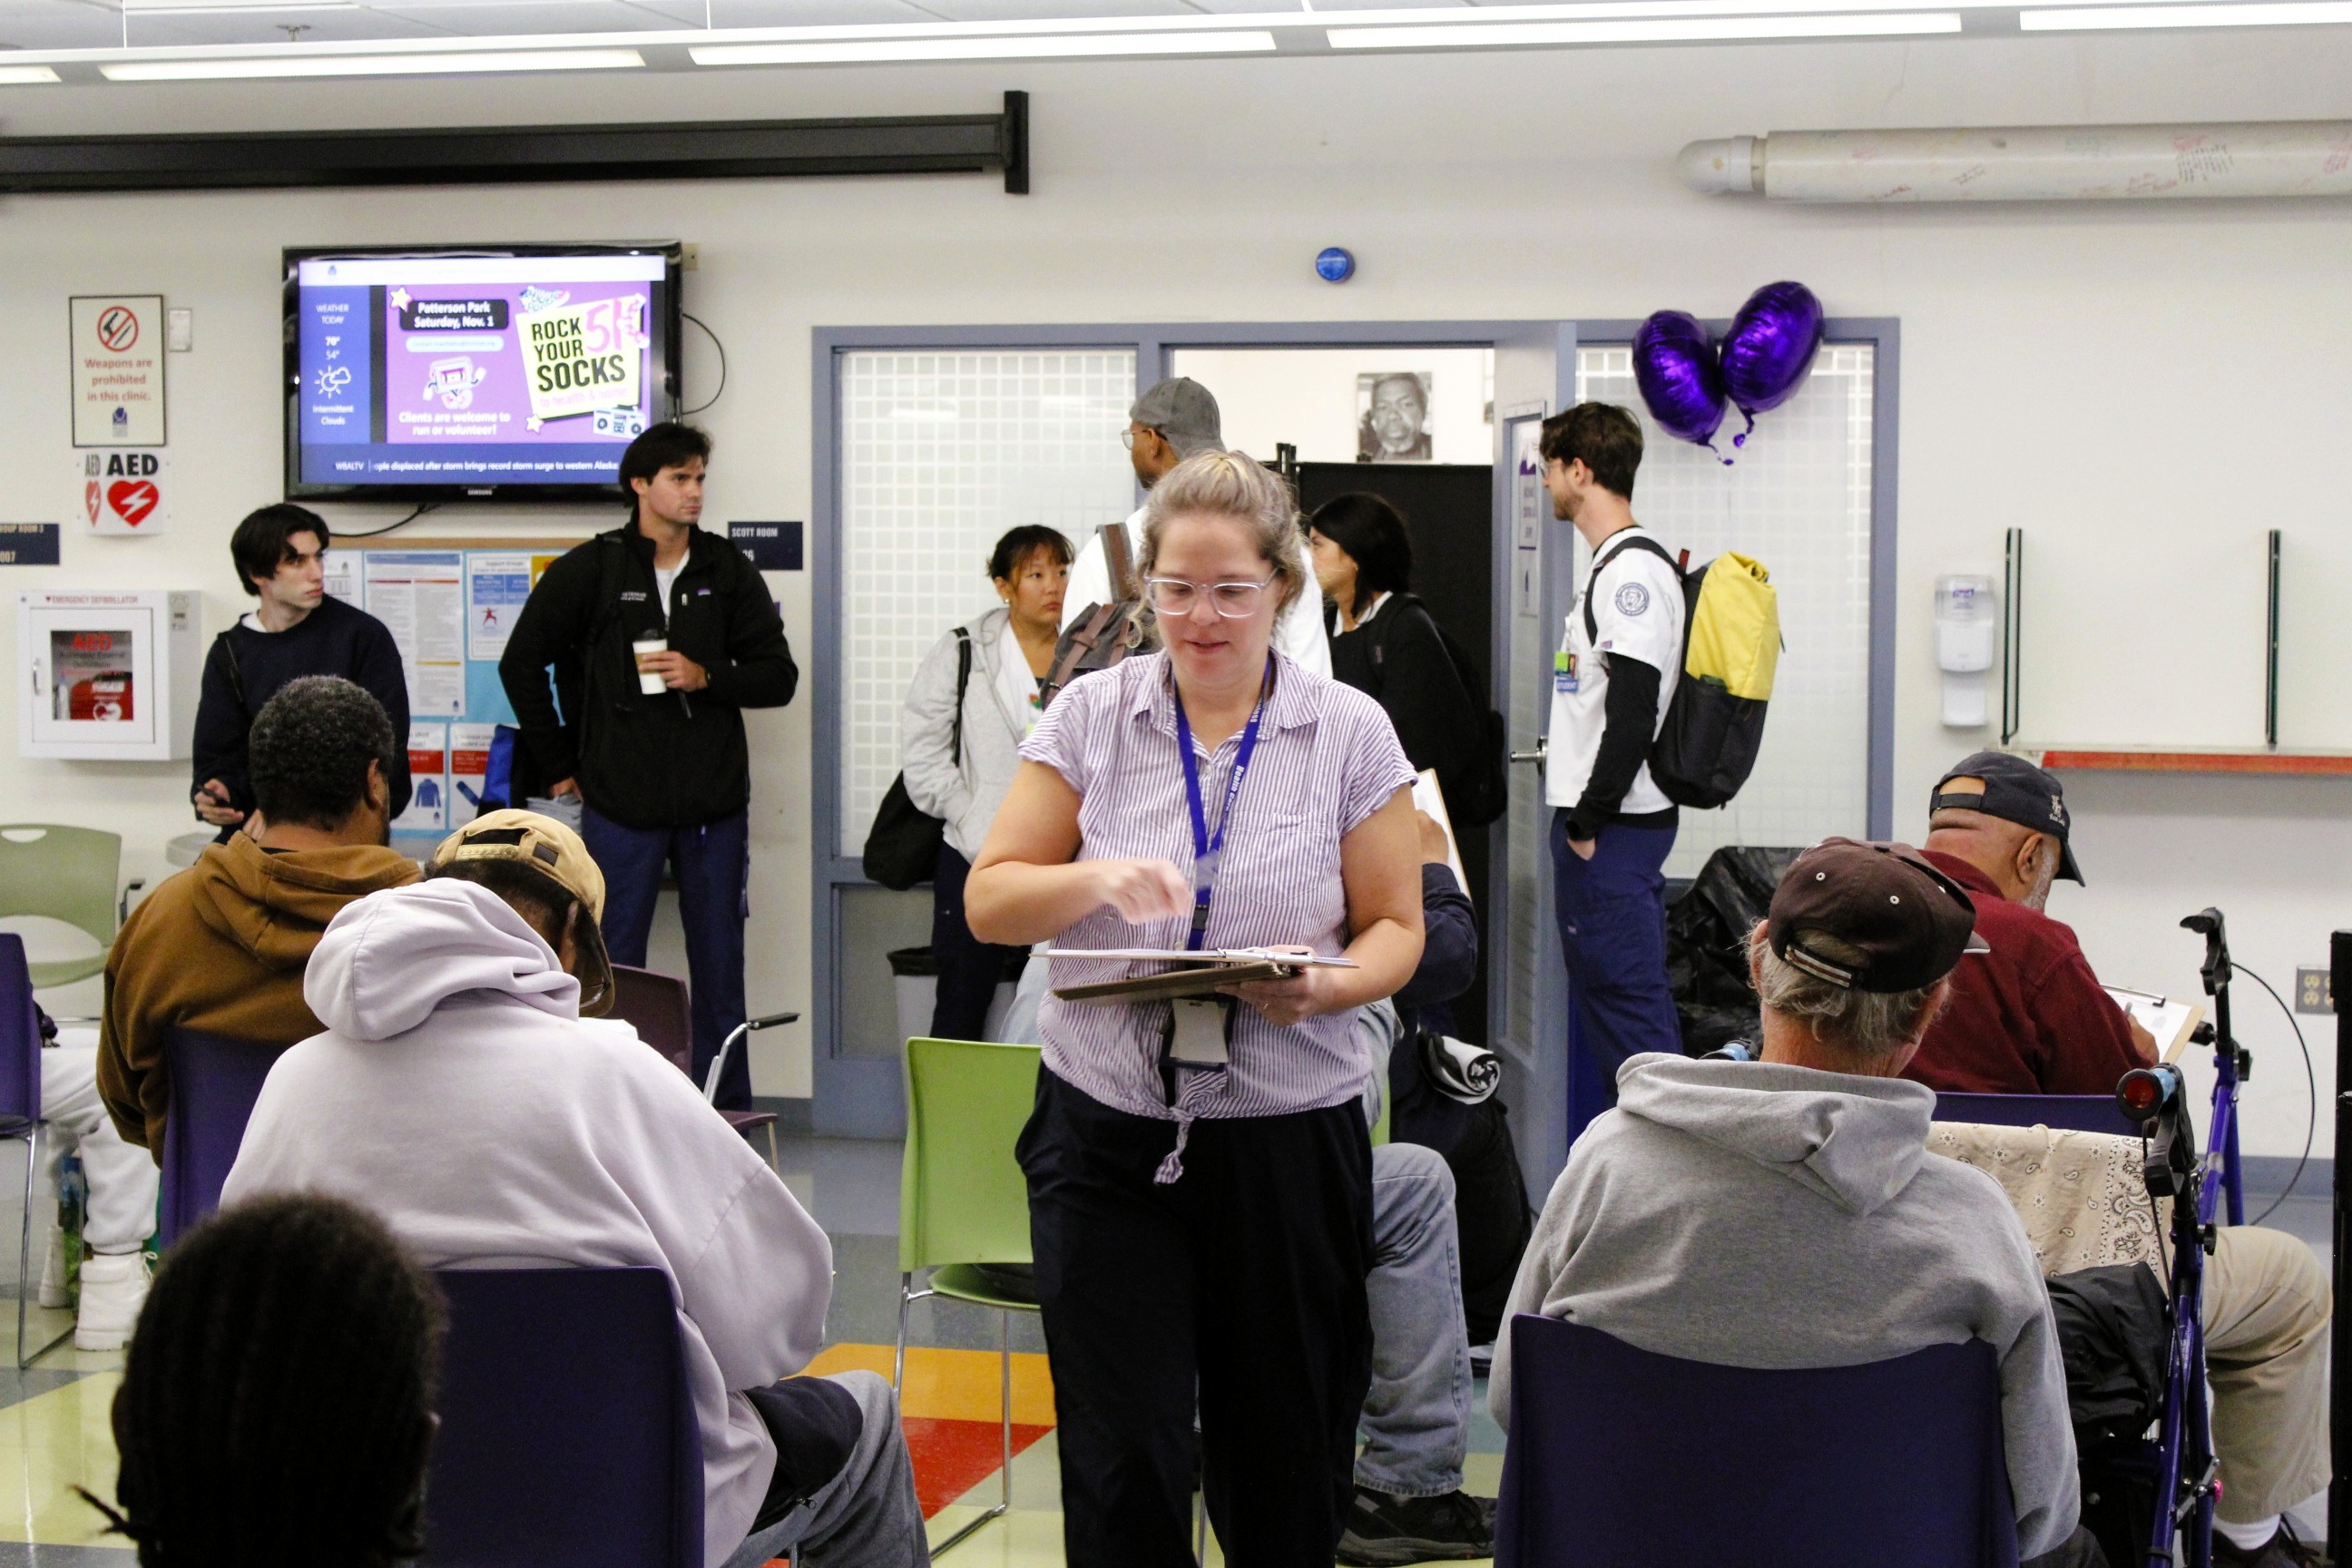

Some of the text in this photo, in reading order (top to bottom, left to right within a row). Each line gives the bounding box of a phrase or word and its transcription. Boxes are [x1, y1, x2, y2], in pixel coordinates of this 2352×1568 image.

[316, 303, 349, 313] WEATHER
[417, 300, 491, 314] Patterson Park
[321, 315, 345, 325] TODAY
[414, 315, 495, 329] Saturday, Nov. 1
[531, 317, 582, 341] ROCK
[534, 338, 583, 362] YOUR
[84, 358, 153, 370] Weapons are
[536, 354, 626, 392] SOCKS
[92, 374, 147, 387] prohibited
[87, 391, 151, 401] in this clinic.
[312, 405, 355, 414] Intermittent
[320, 416, 346, 426] Clouds
[398, 411, 512, 424] Clients are welcome to
[412, 423, 497, 436] run or volunteer!
[107, 454, 159, 476] AED
[335, 460, 364, 471] WBALTV
[390, 461, 425, 473] displaced
[425, 461, 442, 471] after
[442, 461, 464, 471] storm
[464, 460, 487, 473] brings
[488, 461, 512, 471] record
[512, 461, 533, 471] storm
[534, 461, 554, 473] surge
[555, 461, 564, 471] to
[564, 461, 593, 471] western
[18, 524, 38, 534] ROOM
[731, 526, 779, 538] SCOTT ROOM
[72, 633, 113, 651] AED
[1230, 764, 1245, 793] Health
